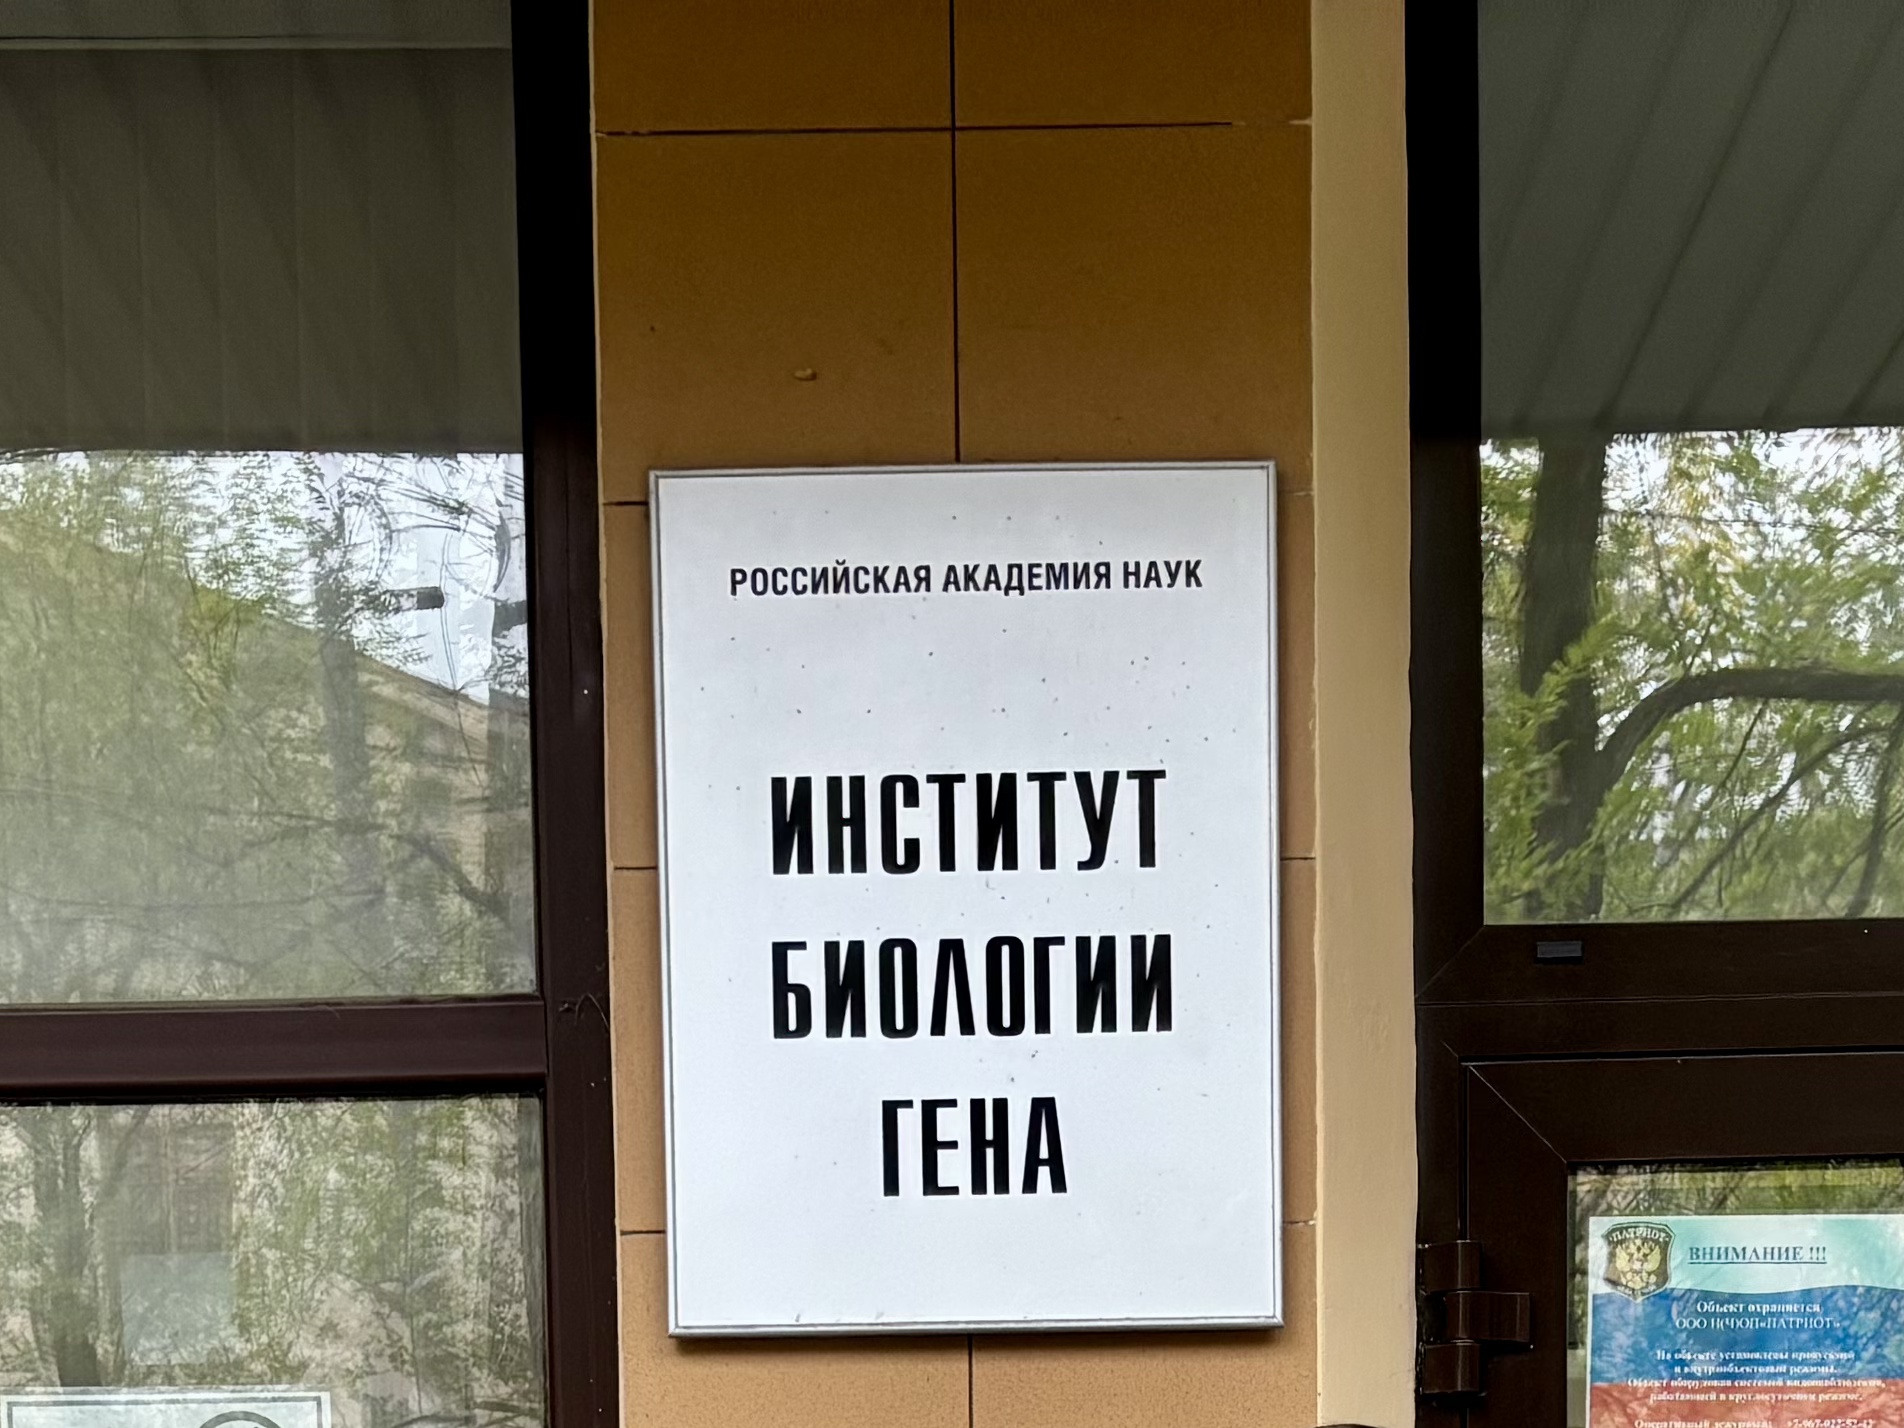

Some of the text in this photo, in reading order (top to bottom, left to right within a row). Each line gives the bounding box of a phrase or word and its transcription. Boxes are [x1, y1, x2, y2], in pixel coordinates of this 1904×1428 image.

[731, 559, 1202, 596] РОССИЙСКАЯ АКАДЕМИЯ НАУК
[772, 770, 1166, 874] ИНСТИТУТ
[772, 934, 1172, 1038] БИОЛОГИИ
[882, 1097, 1067, 1196] ГЕНА
[1689, 1246, 1826, 1261] ВНИМАНИЕ !!!
[1676, 1317, 1707, 1330] ООО
[1696, 1301, 1821, 1316] Объект охраняется
